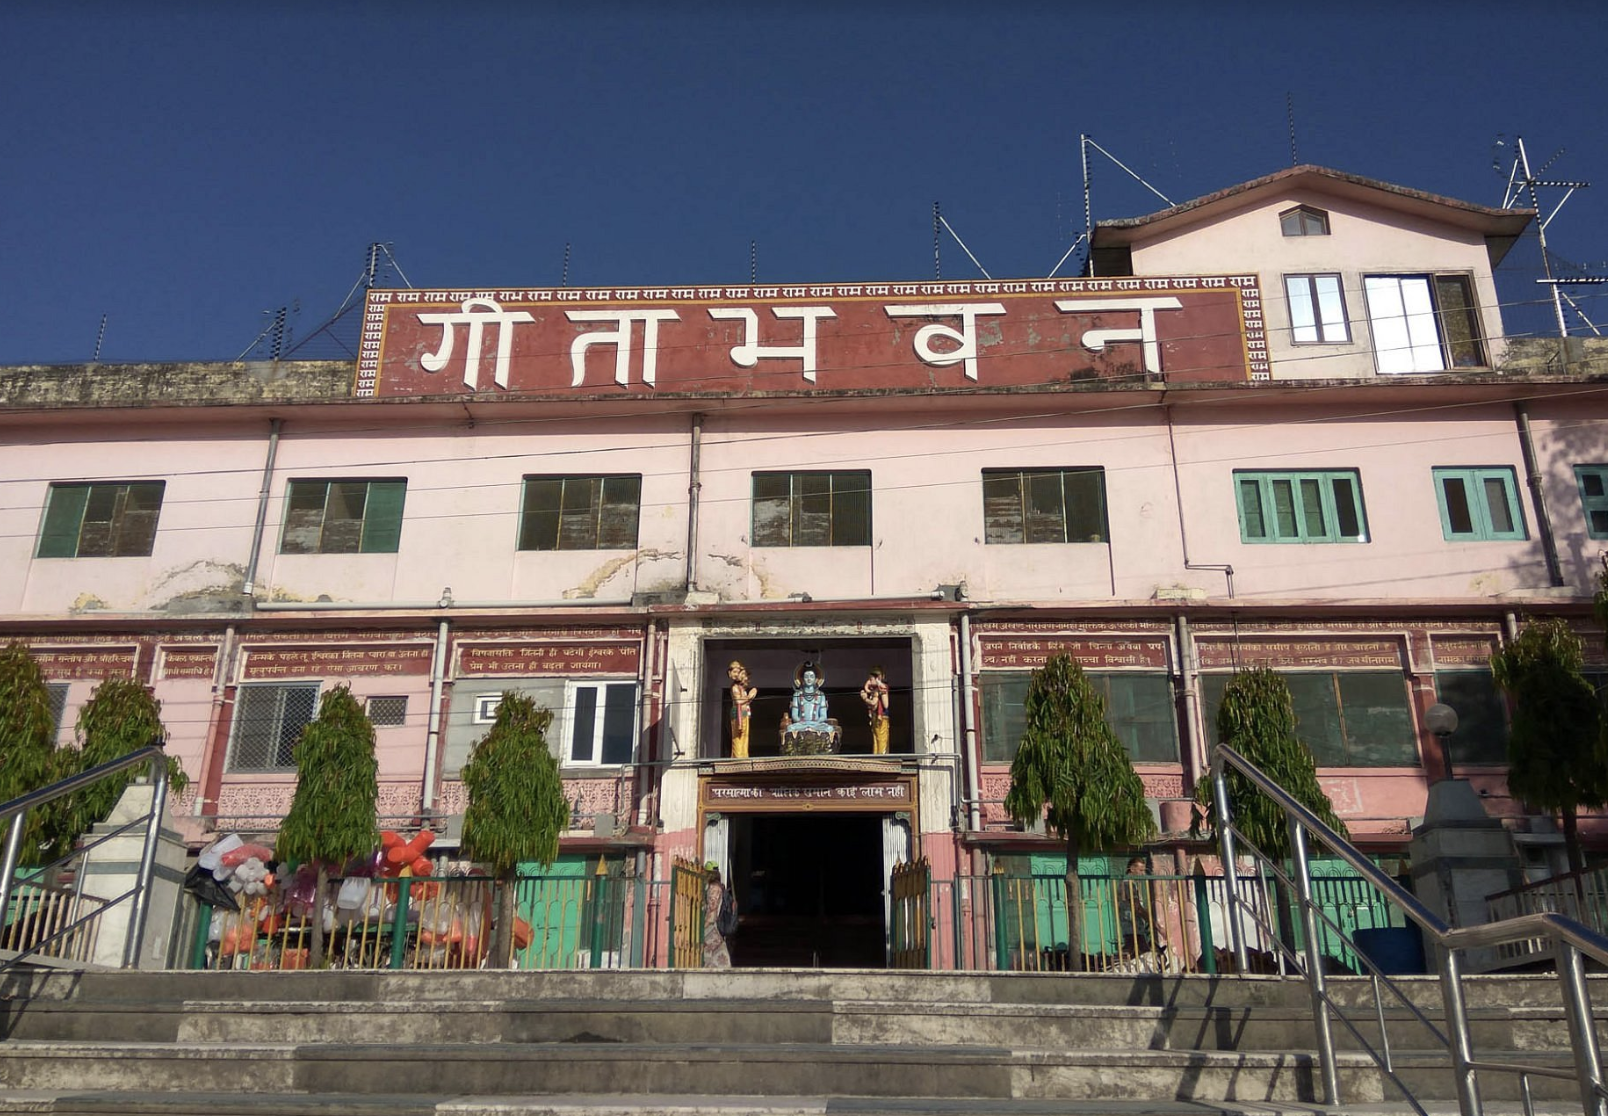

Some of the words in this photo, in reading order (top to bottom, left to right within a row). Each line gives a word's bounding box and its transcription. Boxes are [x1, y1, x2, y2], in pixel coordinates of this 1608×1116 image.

[370, 292, 392, 302] राम
[397, 292, 420, 302] राम
[424, 292, 448, 302] राम
[500, 291, 524, 301] राम
[528, 291, 552, 301] राम
[557, 290, 582, 300] राम
[586, 290, 611, 300] राम
[615, 290, 640, 300] राम
[643, 289, 669, 299] राम
[672, 289, 694, 299] राम
[698, 289, 722, 299] राम
[726, 288, 749, 298] राम
[753, 288, 779, 298] राम
[782, 287, 807, 297] राम
[810, 287, 834, 297] राम
[837, 286, 862, 296] राम
[865, 286, 889, 296] राम
[893, 285, 918, 295] राम
[920, 284, 945, 294] राम
[947, 284, 971, 294] राम
[974, 283, 1000, 293] राम
[1003, 283, 1027, 293] राम
[1031, 282, 1055, 292] राम
[1059, 281, 1085, 291] राम
[1087, 280, 1113, 290] राम
[1117, 280, 1142, 290] राम
[1144, 279, 1169, 289] राम
[1172, 279, 1199, 289] राम
[1201, 278, 1227, 288] राम
[1230, 278, 1256, 288] राम
[1242, 289, 1258, 297] राम
[368, 304, 384, 312] राम
[1244, 310, 1261, 318] राम
[365, 332, 382, 340] राम
[1248, 351, 1266, 359] राम
[1250, 362, 1268, 370] राम
[1252, 372, 1269, 380] राम
